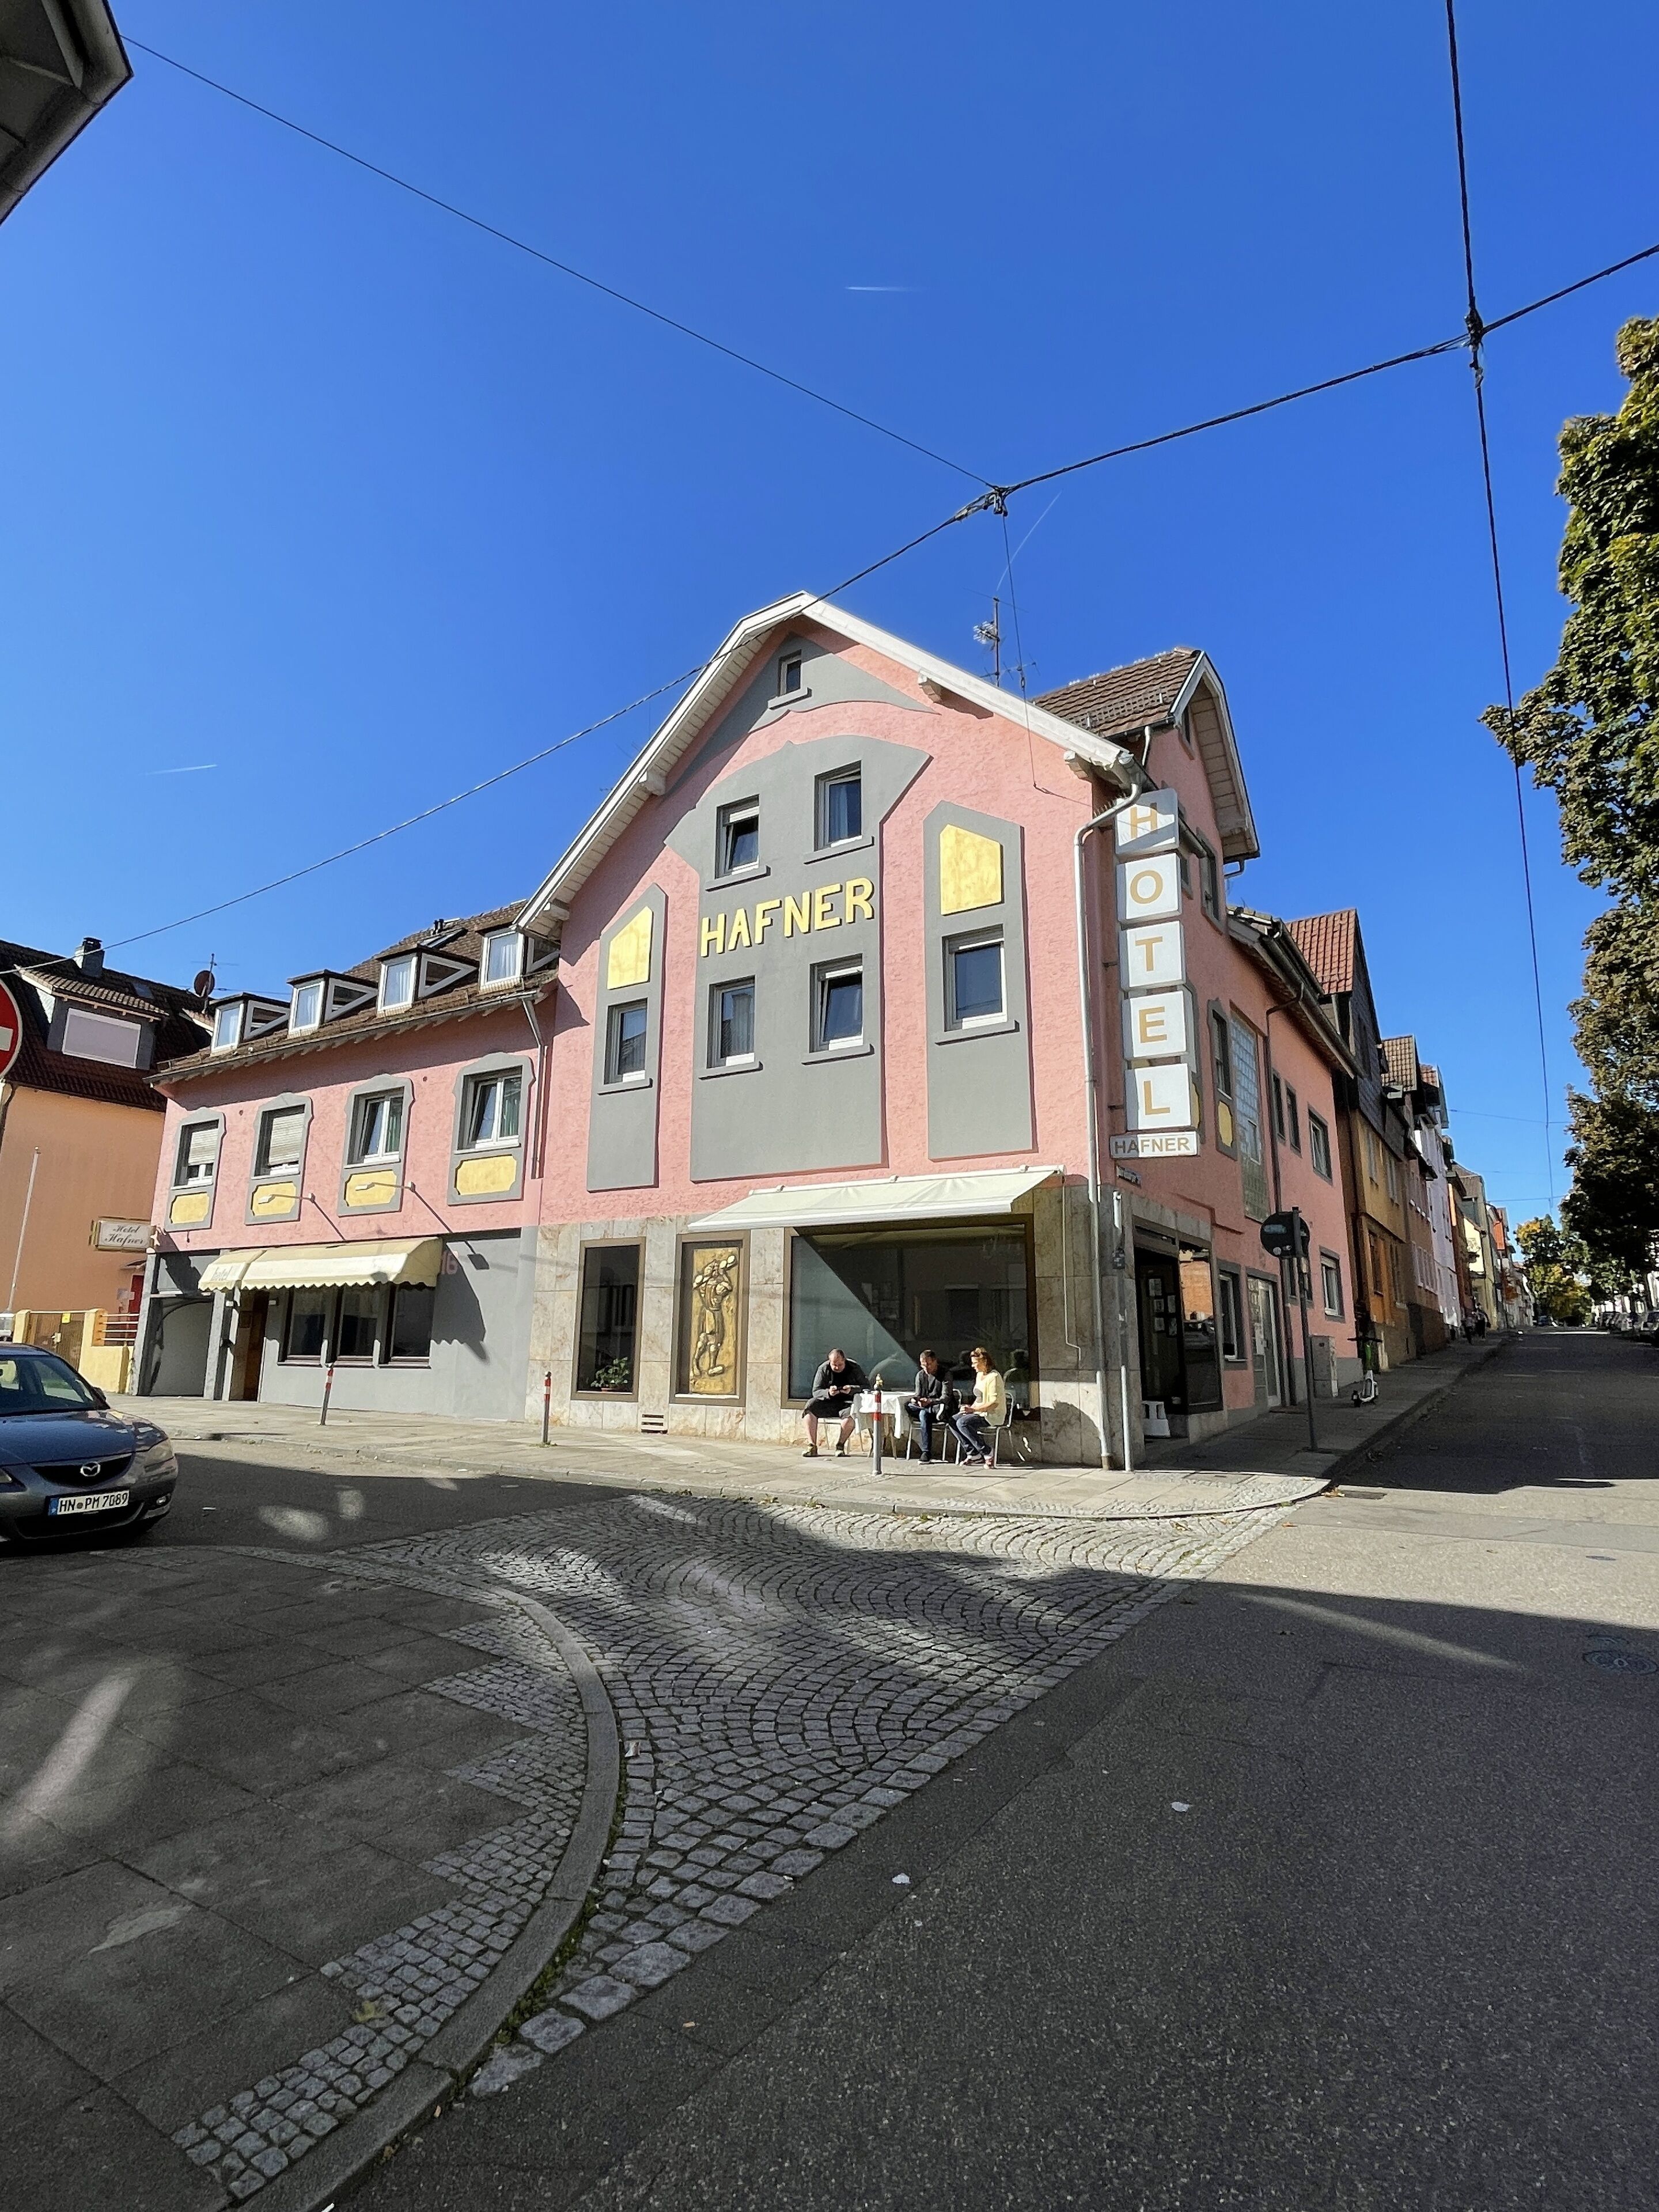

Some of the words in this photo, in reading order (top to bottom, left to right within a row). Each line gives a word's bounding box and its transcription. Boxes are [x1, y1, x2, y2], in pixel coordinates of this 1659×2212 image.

[700, 877, 874, 957] HAFNER
[1129, 801, 1171, 1116] HOTEL
[1114, 1137, 1191, 1154] HAFNER
[59, 1499, 76, 1512] HN
[85, 1496, 100, 1510] PM
